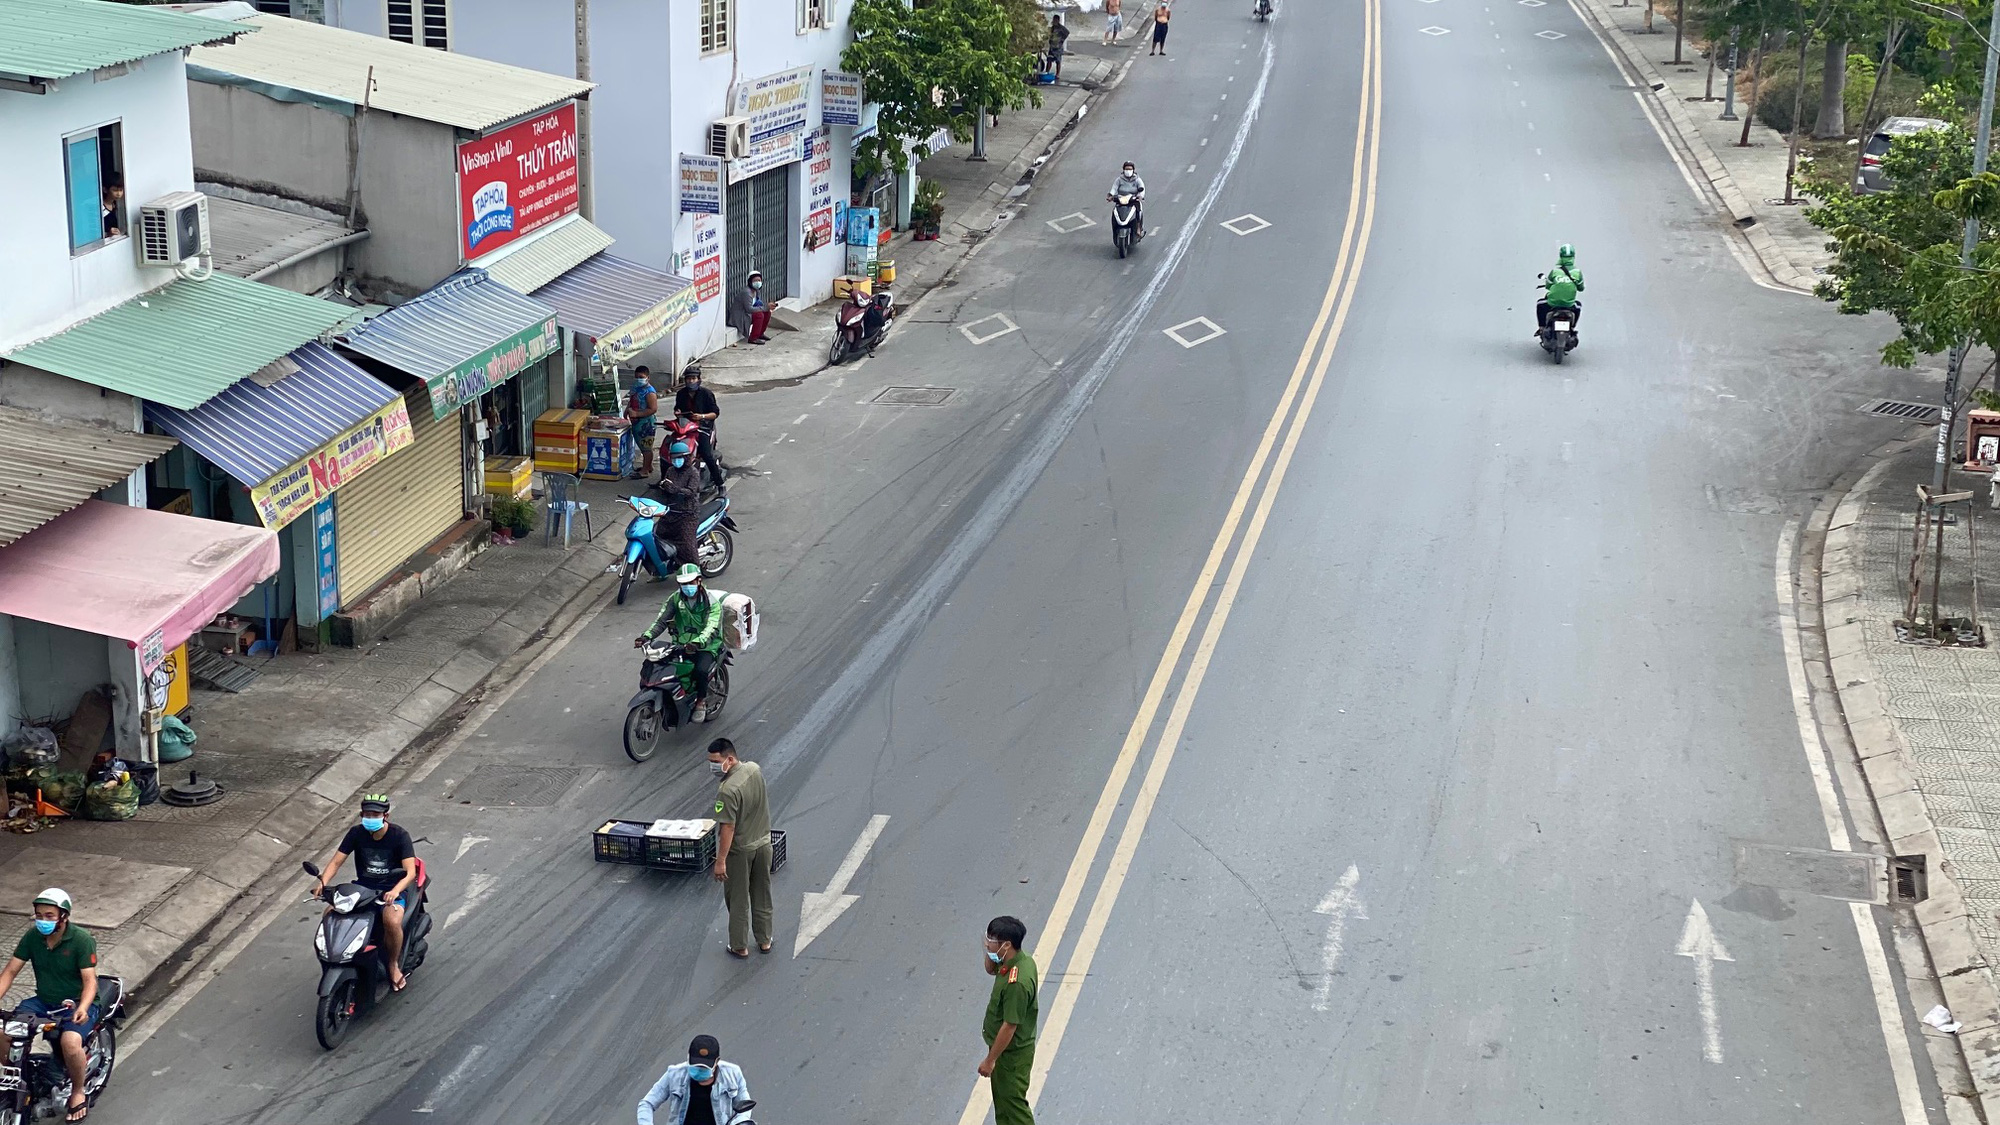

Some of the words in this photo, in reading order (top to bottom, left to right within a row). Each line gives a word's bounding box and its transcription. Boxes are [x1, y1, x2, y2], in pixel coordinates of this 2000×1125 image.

[756, 81, 768, 89] CÔNG
[786, 74, 797, 82] LẠNH
[748, 91, 772, 112] NGỌC
[774, 82, 802, 104] THIỆN
[824, 84, 839, 97] NGỌC
[840, 84, 857, 98] THIỆN
[533, 120, 545, 136] TẠP
[546, 114, 559, 131] HÓA
[517, 144, 545, 180] THÚY
[547, 130, 575, 166] TRẦN
[761, 140, 776, 154] NGỌC
[812, 141, 830, 156] NGỌC
[462, 152, 490, 175] VinShop
[495, 140, 512, 162] VinID
[810, 157, 831, 175] THIỆN
[682, 169, 698, 183] NGỌC
[699, 168, 718, 184] THIỆN
[484, 215, 498, 232] CÔNG
[697, 230, 703, 244] VỆ
[705, 228, 716, 240] SINH
[695, 246, 705, 260] MÁY
[706, 242, 719, 256] LẠNH
[1555, 275, 1576, 284] Gra
[309, 452, 341, 498] Na
